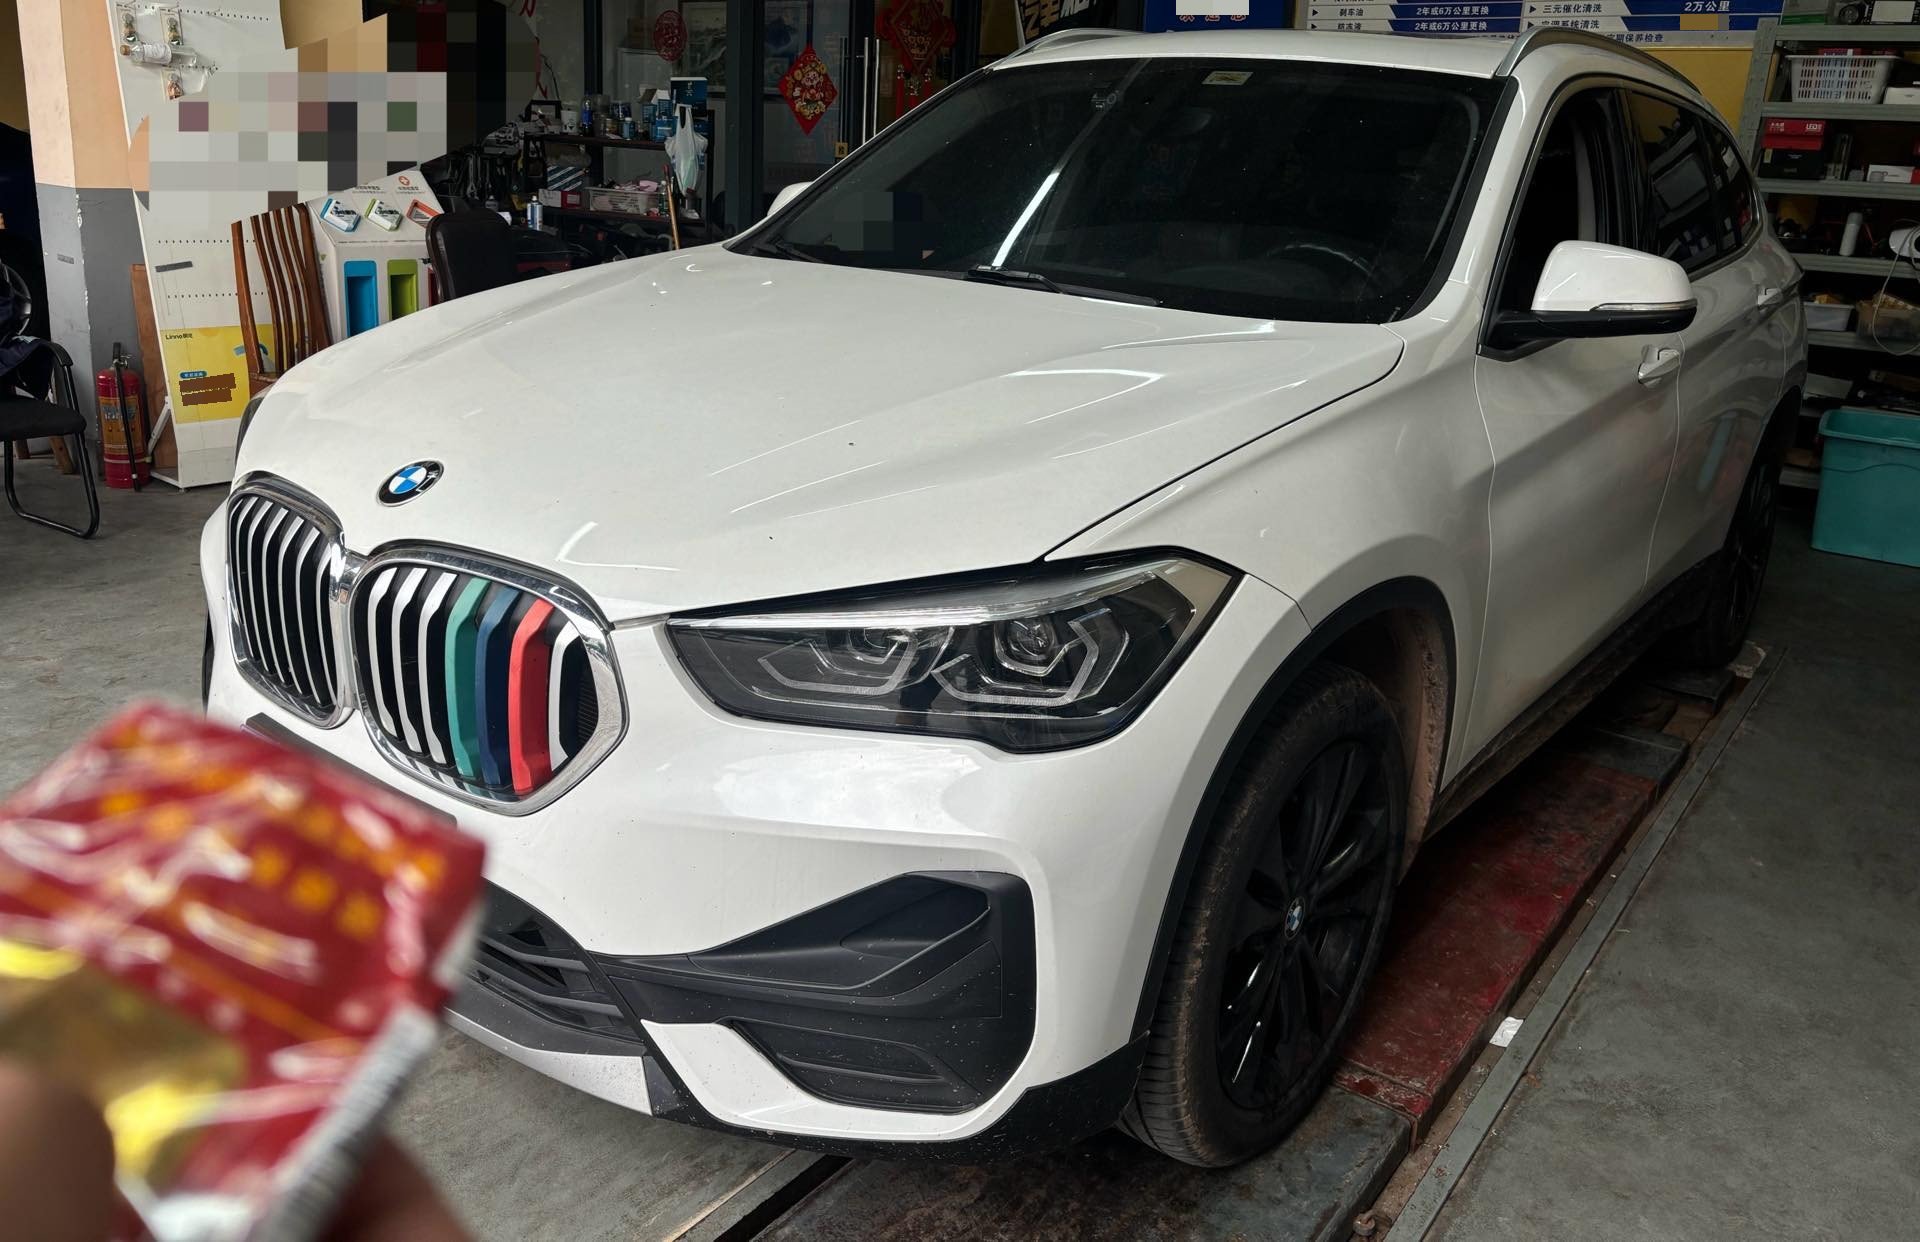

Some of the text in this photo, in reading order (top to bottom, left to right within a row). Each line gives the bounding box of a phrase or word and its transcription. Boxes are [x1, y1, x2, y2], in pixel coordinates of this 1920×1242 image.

[1543, 4, 1602, 13] 三元催化清洗
[1684, 1, 1730, 12] 2万公里
[1416, 7, 1489, 16] 2年或6万公里更换
[1414, 21, 1487, 31] 2年或6万公里更换
